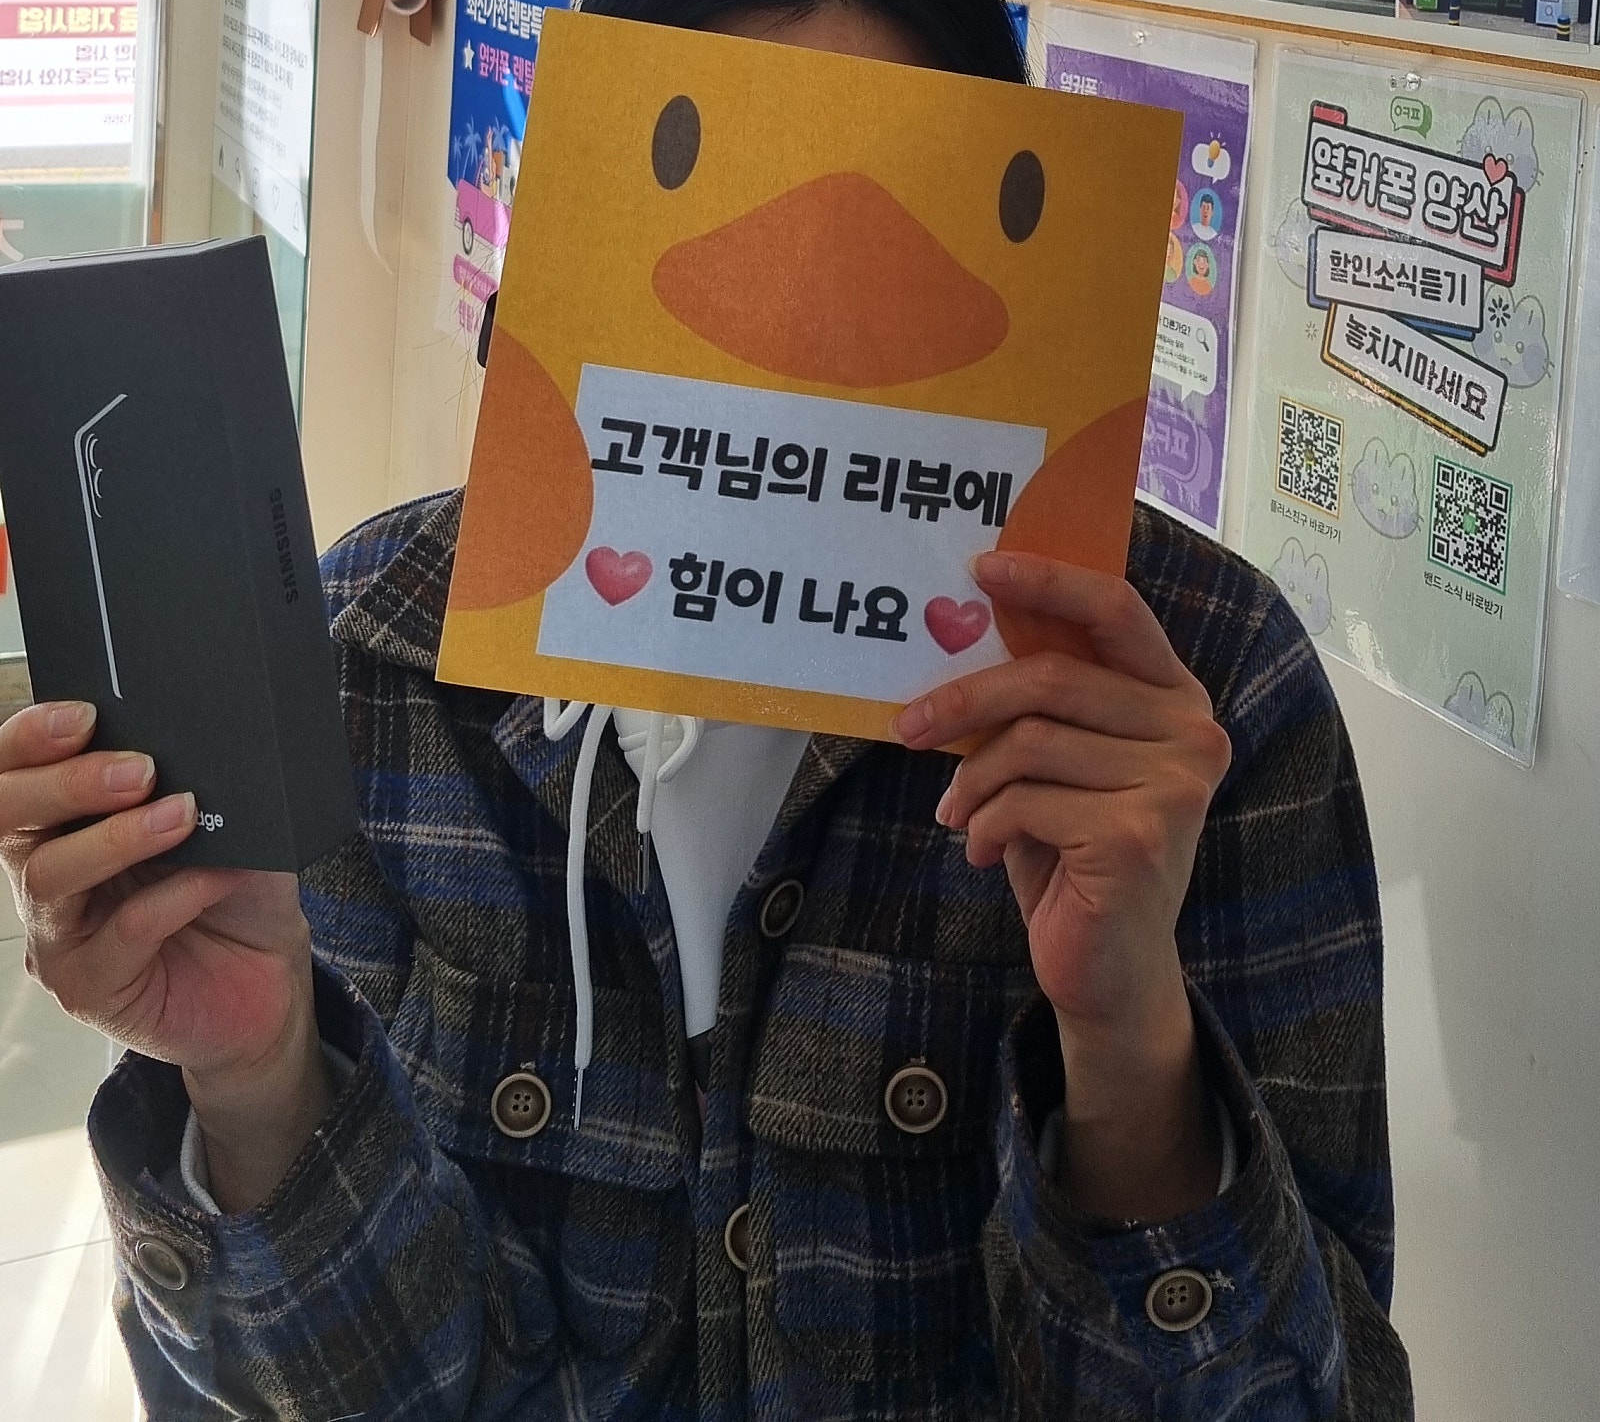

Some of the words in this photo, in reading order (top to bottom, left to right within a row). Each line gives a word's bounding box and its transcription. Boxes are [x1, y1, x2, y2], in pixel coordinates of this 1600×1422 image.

[1311, 135, 1417, 221] 옆커폰
[1421, 169, 1510, 249] 양산
[1329, 249, 1468, 307] 할인소식듣기
[1162, 316, 1191, 337] 다른가요?
[1345, 313, 1488, 423] 놓치지마세요
[590, 416, 829, 503] 고객님의
[843, 452, 1014, 529] 리뷰에
[269, 486, 300, 606] SAMSUNG
[1309, 518, 1342, 544] 바로가기
[668, 551, 785, 625] 힘이
[798, 576, 910, 643] 나요
[1423, 570, 1443, 590] 밴드
[1443, 579, 1464, 602] 소식
[1464, 589, 1504, 620] 바로받기
[197, 810, 224, 832] dge
